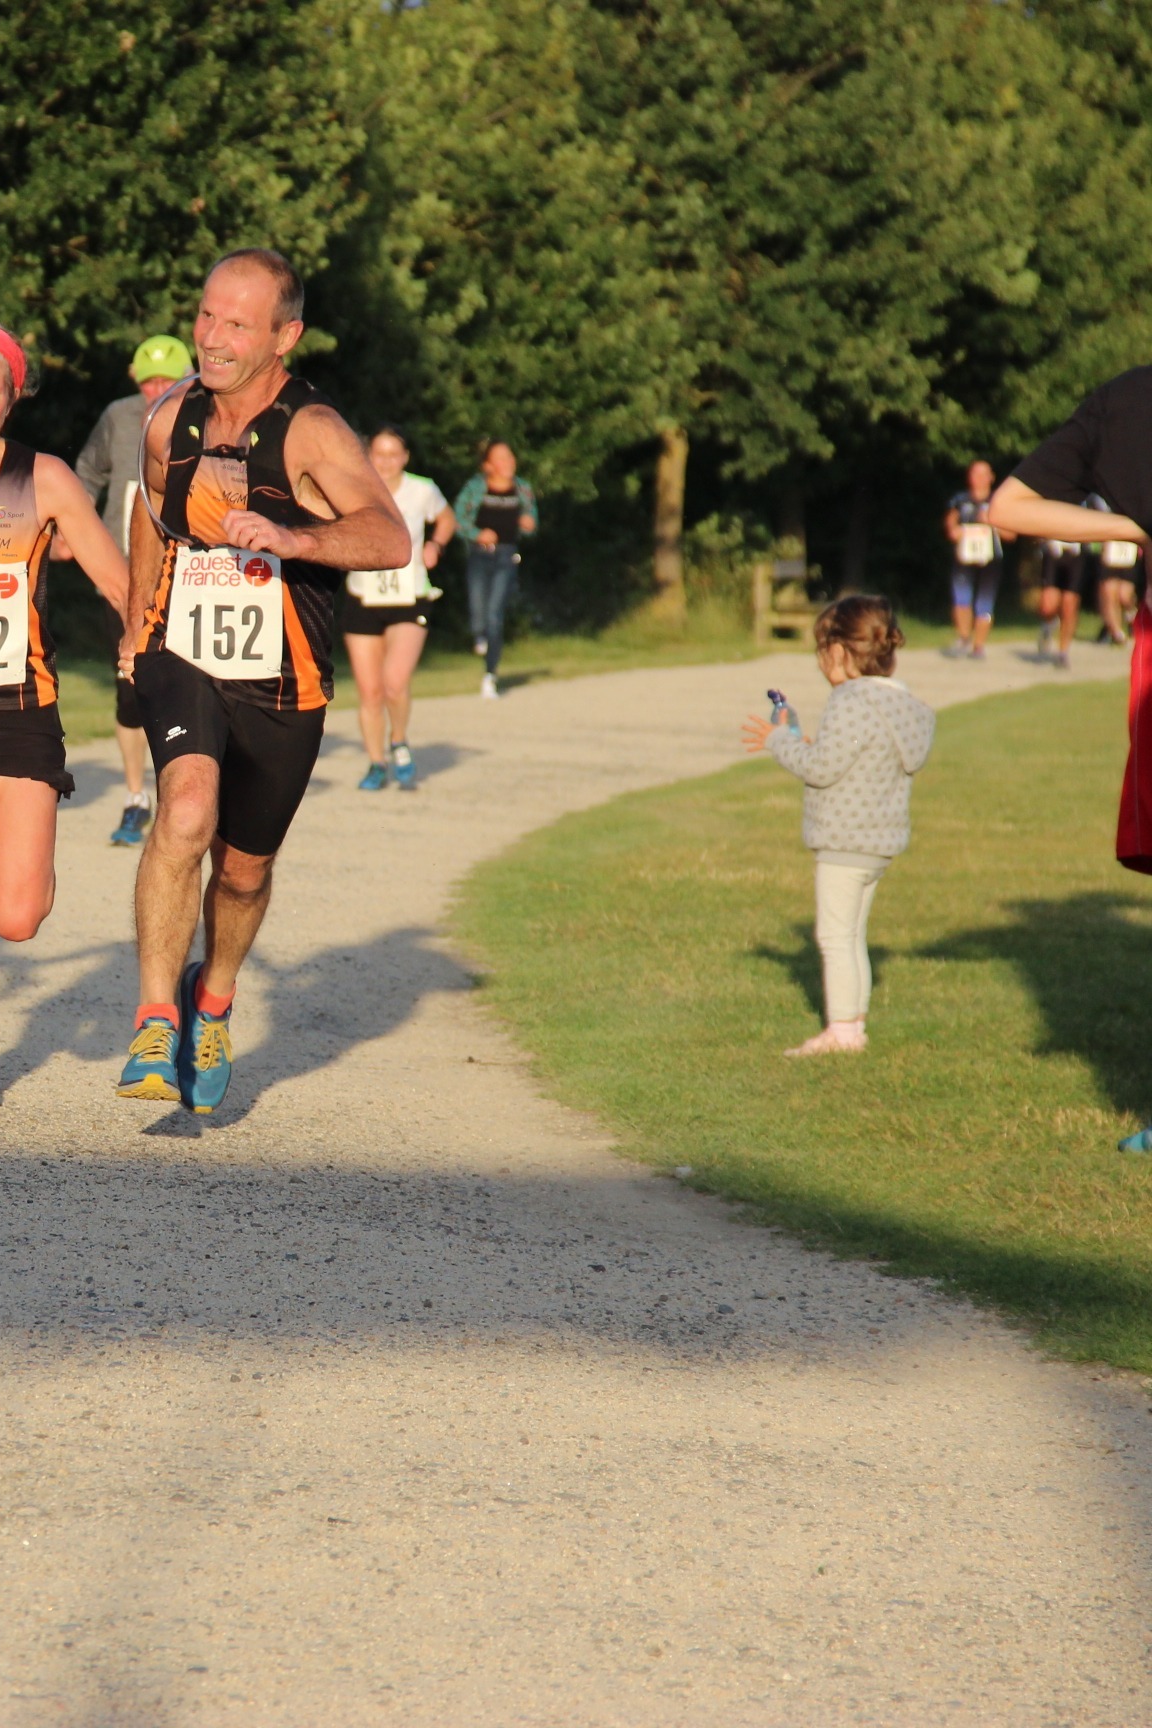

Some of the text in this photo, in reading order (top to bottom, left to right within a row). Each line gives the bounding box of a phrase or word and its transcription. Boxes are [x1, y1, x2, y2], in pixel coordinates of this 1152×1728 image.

[7, 511, 25, 519] Sport
[190, 553, 242, 571] ouest
[181, 569, 241, 587] france
[188, 604, 264, 661] 152
